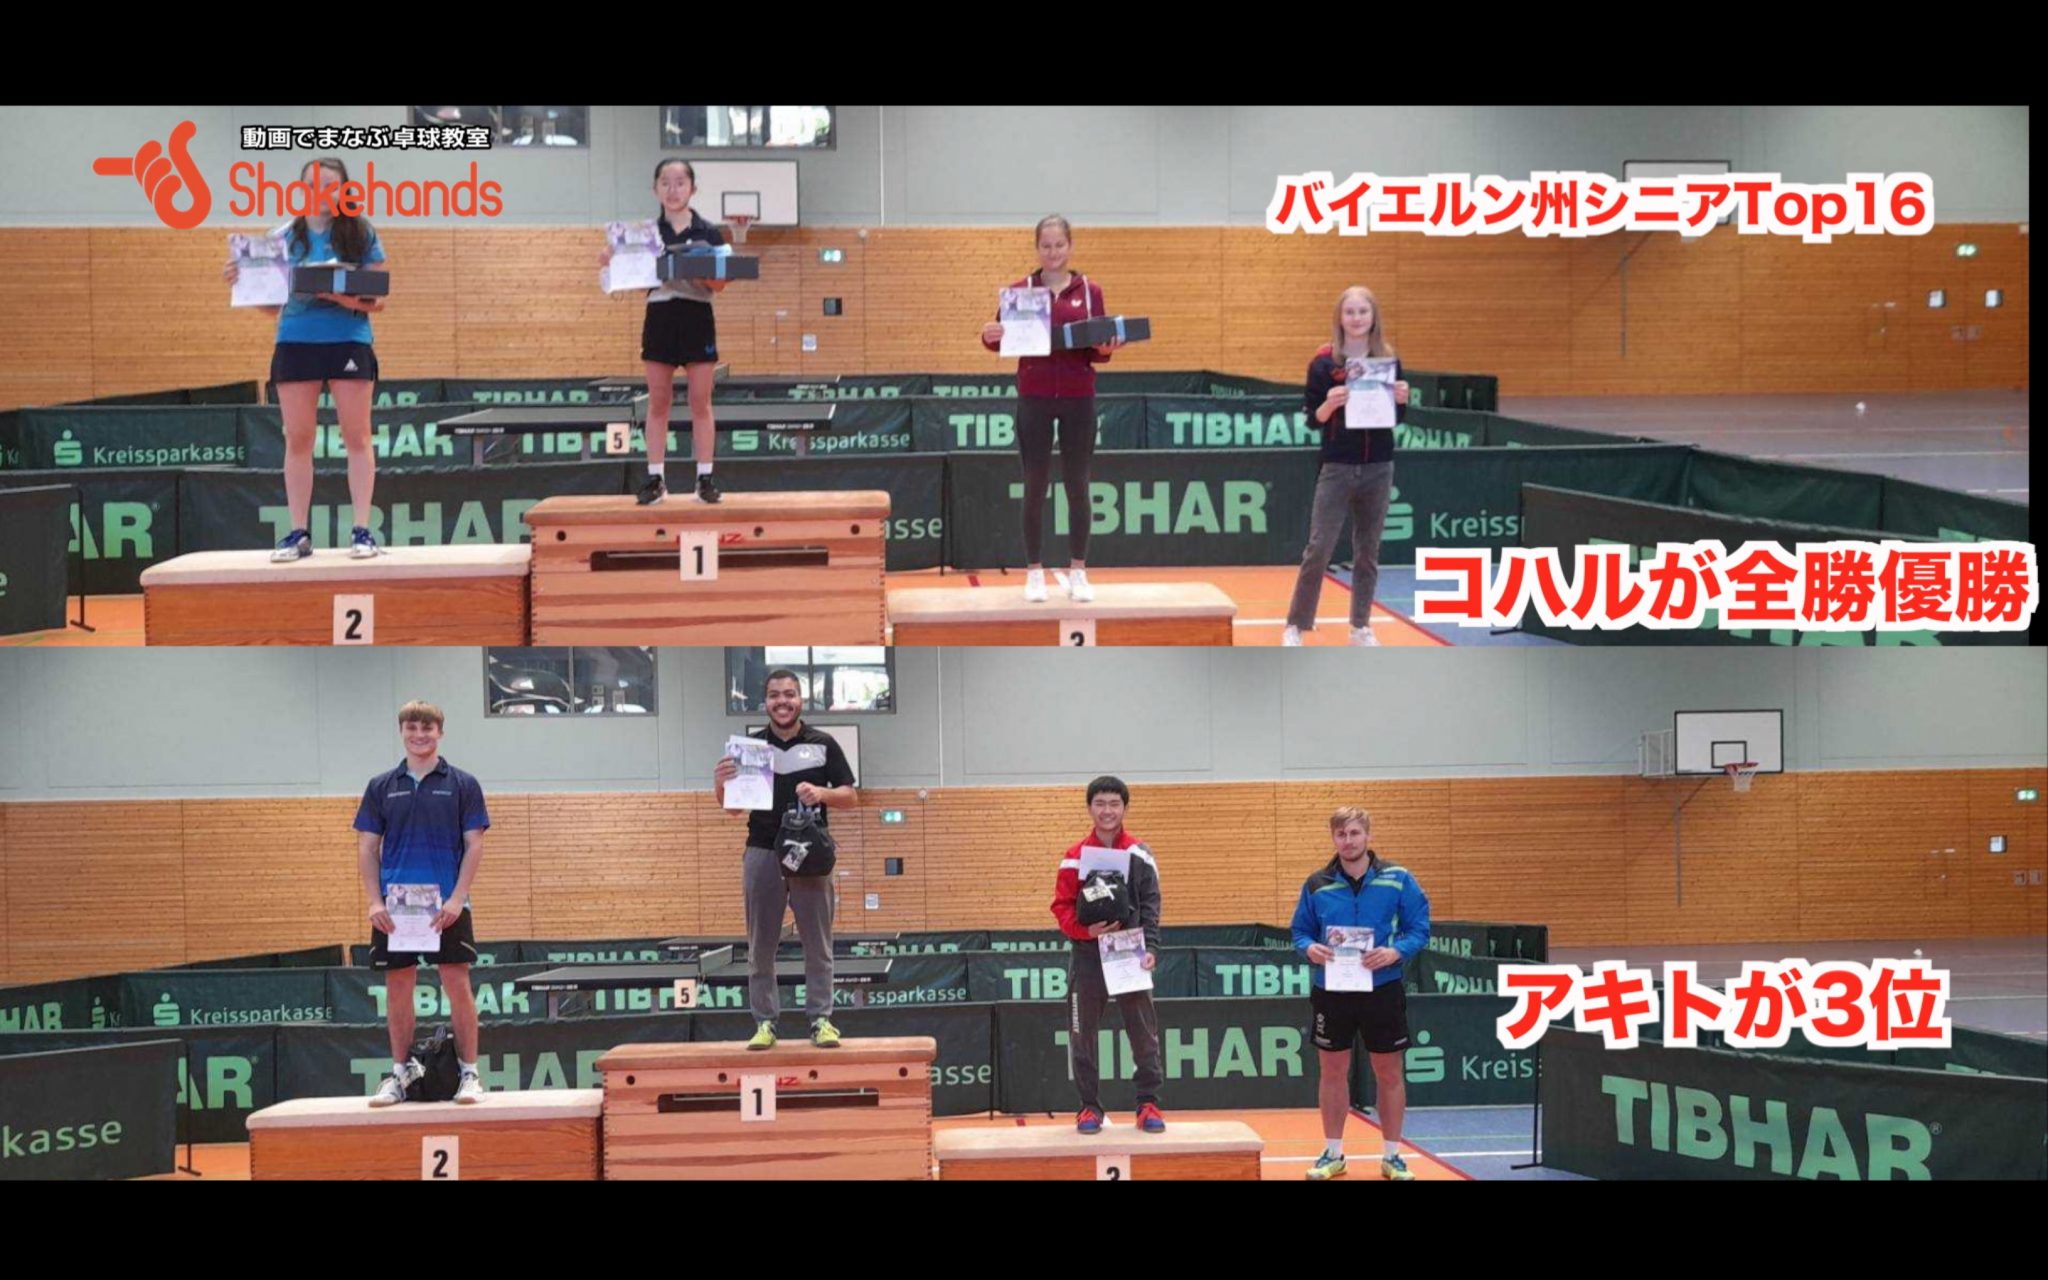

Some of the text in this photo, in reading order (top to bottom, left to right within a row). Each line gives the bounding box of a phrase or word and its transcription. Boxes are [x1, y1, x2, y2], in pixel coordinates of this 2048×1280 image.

[94, 442, 245, 466] Kreissparkasse
[613, 432, 622, 450] 5
[768, 430, 911, 452] Kressparkasse
[1430, 509, 1526, 542] Kreiss
[692, 545, 703, 576] 1
[345, 609, 362, 640] 2
[681, 986, 690, 1004] 5
[191, 1003, 333, 1026] Kreissparkasse
[1461, 1052, 1543, 1081] Kreis
[752, 1087, 762, 1117] 1
[1601, 1074, 1933, 1180] TIBHAR
[433, 1149, 448, 1179] 2
